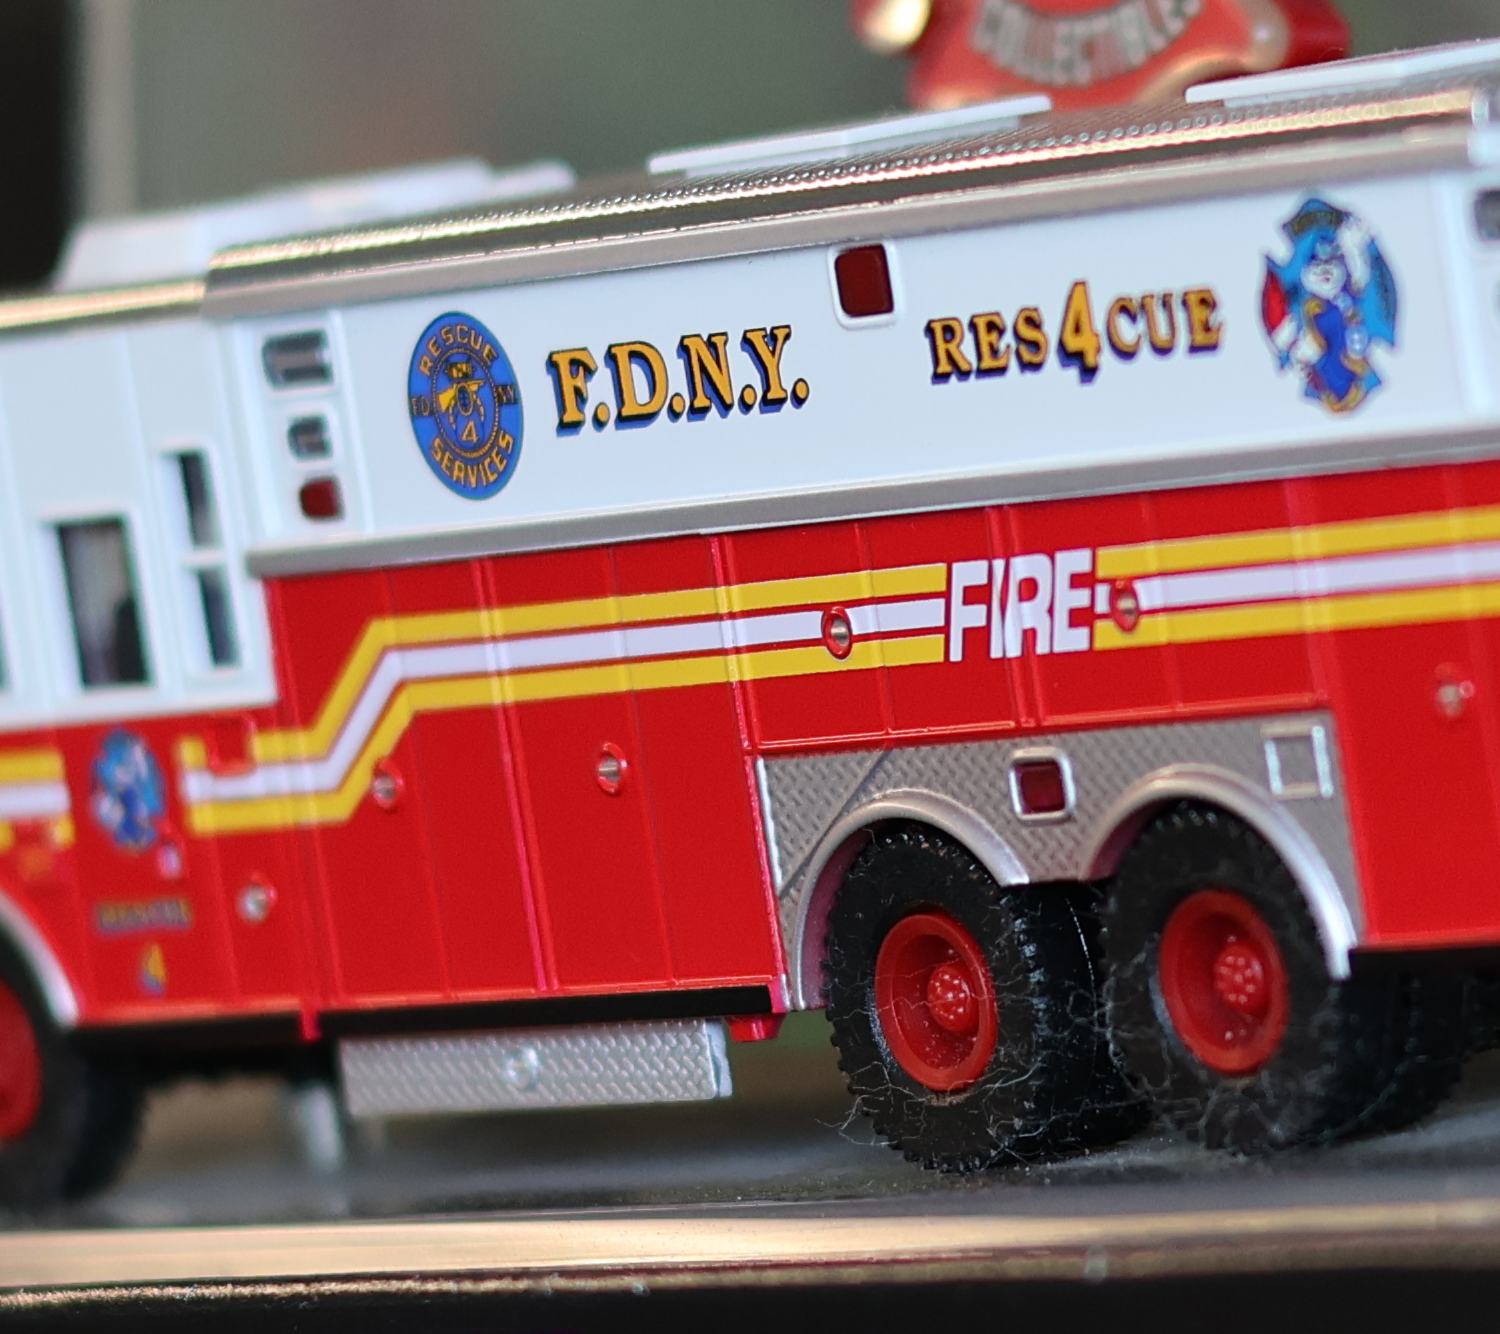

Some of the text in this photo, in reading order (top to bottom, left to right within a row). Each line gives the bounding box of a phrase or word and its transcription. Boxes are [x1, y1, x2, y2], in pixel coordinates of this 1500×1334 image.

[417, 323, 500, 377] RESCUE
[547, 323, 813, 436] F.D.N.Y.
[429, 430, 515, 489] SERVICES
[461, 420, 480, 444] 4
[947, 547, 1097, 663] FIRE
